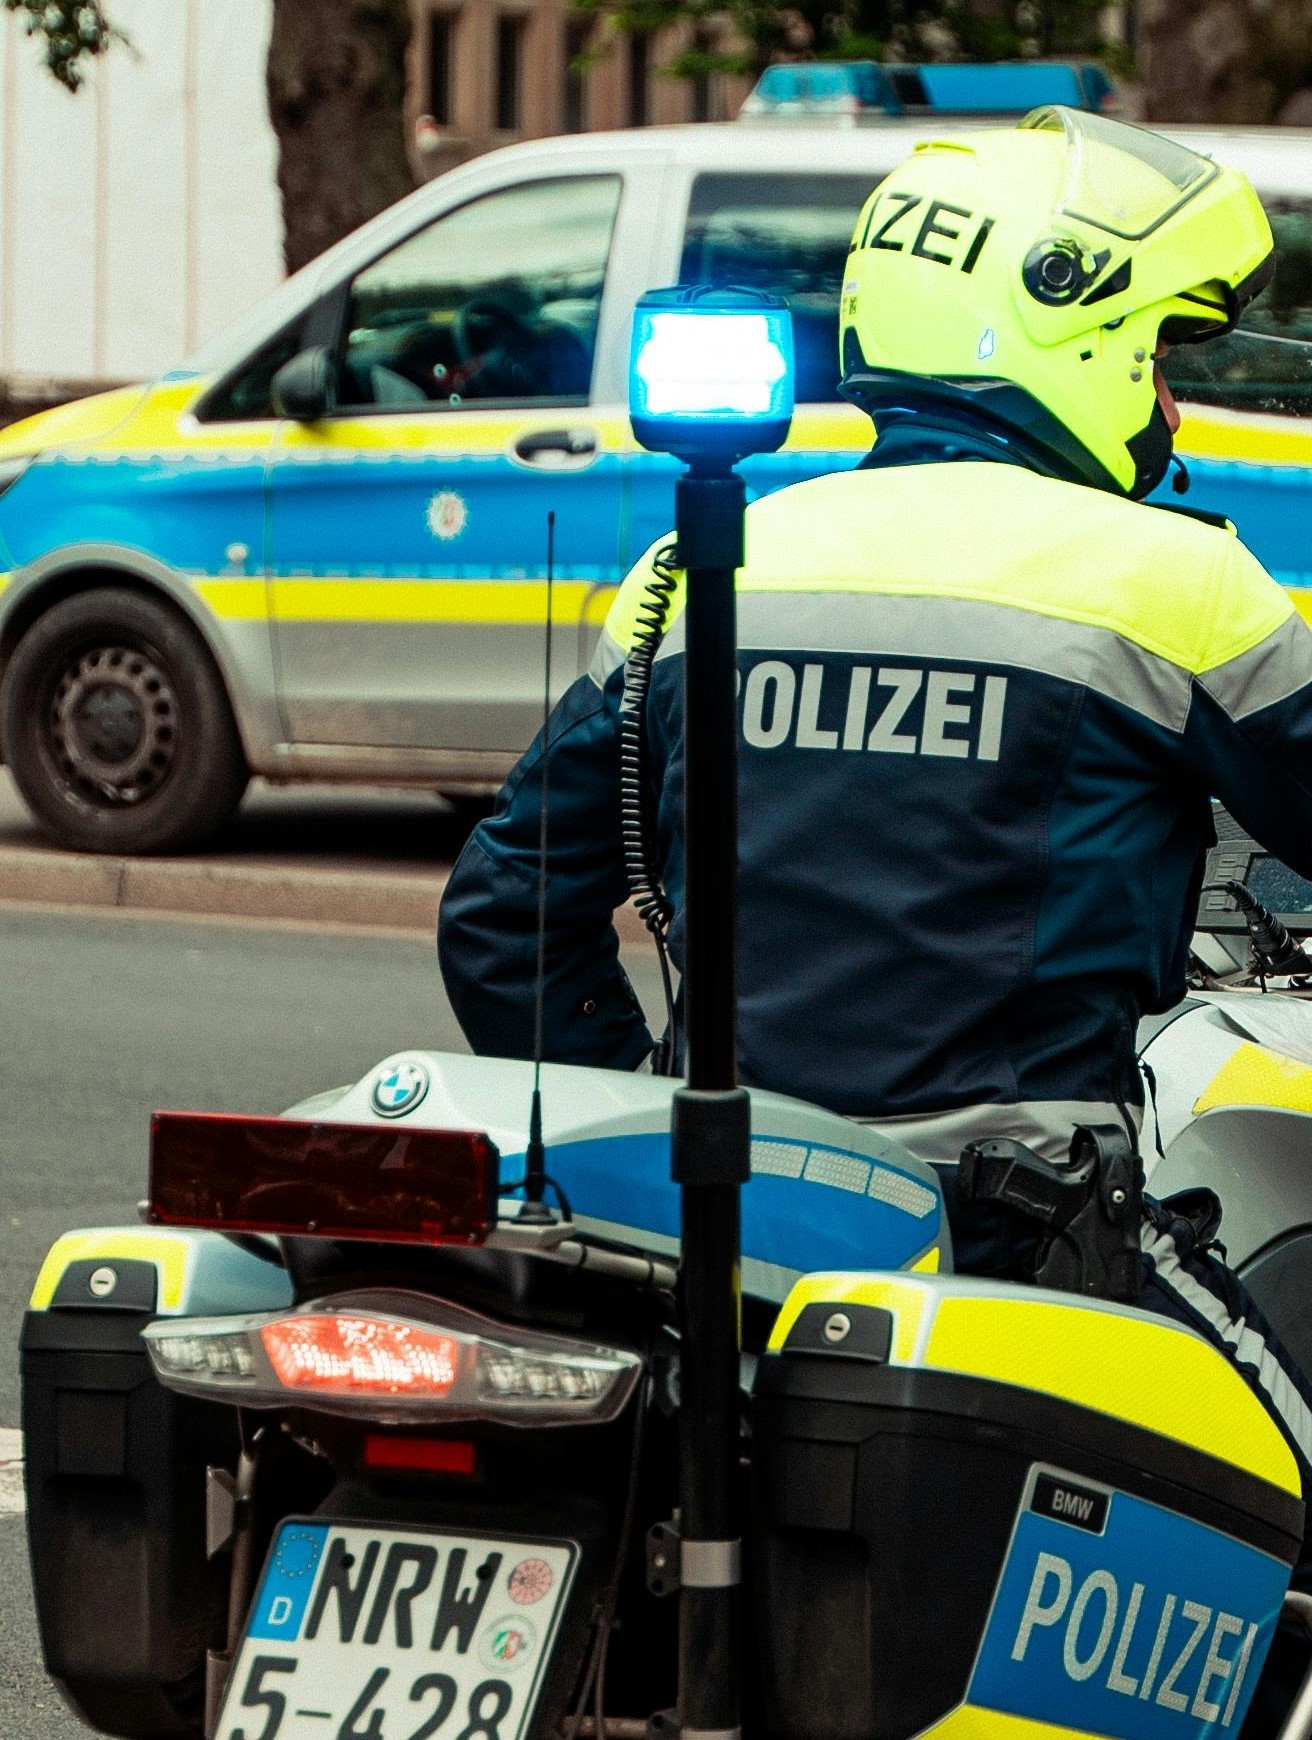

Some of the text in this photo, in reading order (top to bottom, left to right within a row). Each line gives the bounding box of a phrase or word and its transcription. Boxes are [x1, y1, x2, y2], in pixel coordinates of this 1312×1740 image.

[849, 191, 996, 275] IZEI
[736, 660, 1008, 761] OLIZEI
[1052, 1489, 1094, 1521] BMW
[268, 1597, 293, 1625] D
[303, 1537, 503, 1654] NRW
[1011, 1551, 1258, 1727] POLIZEI
